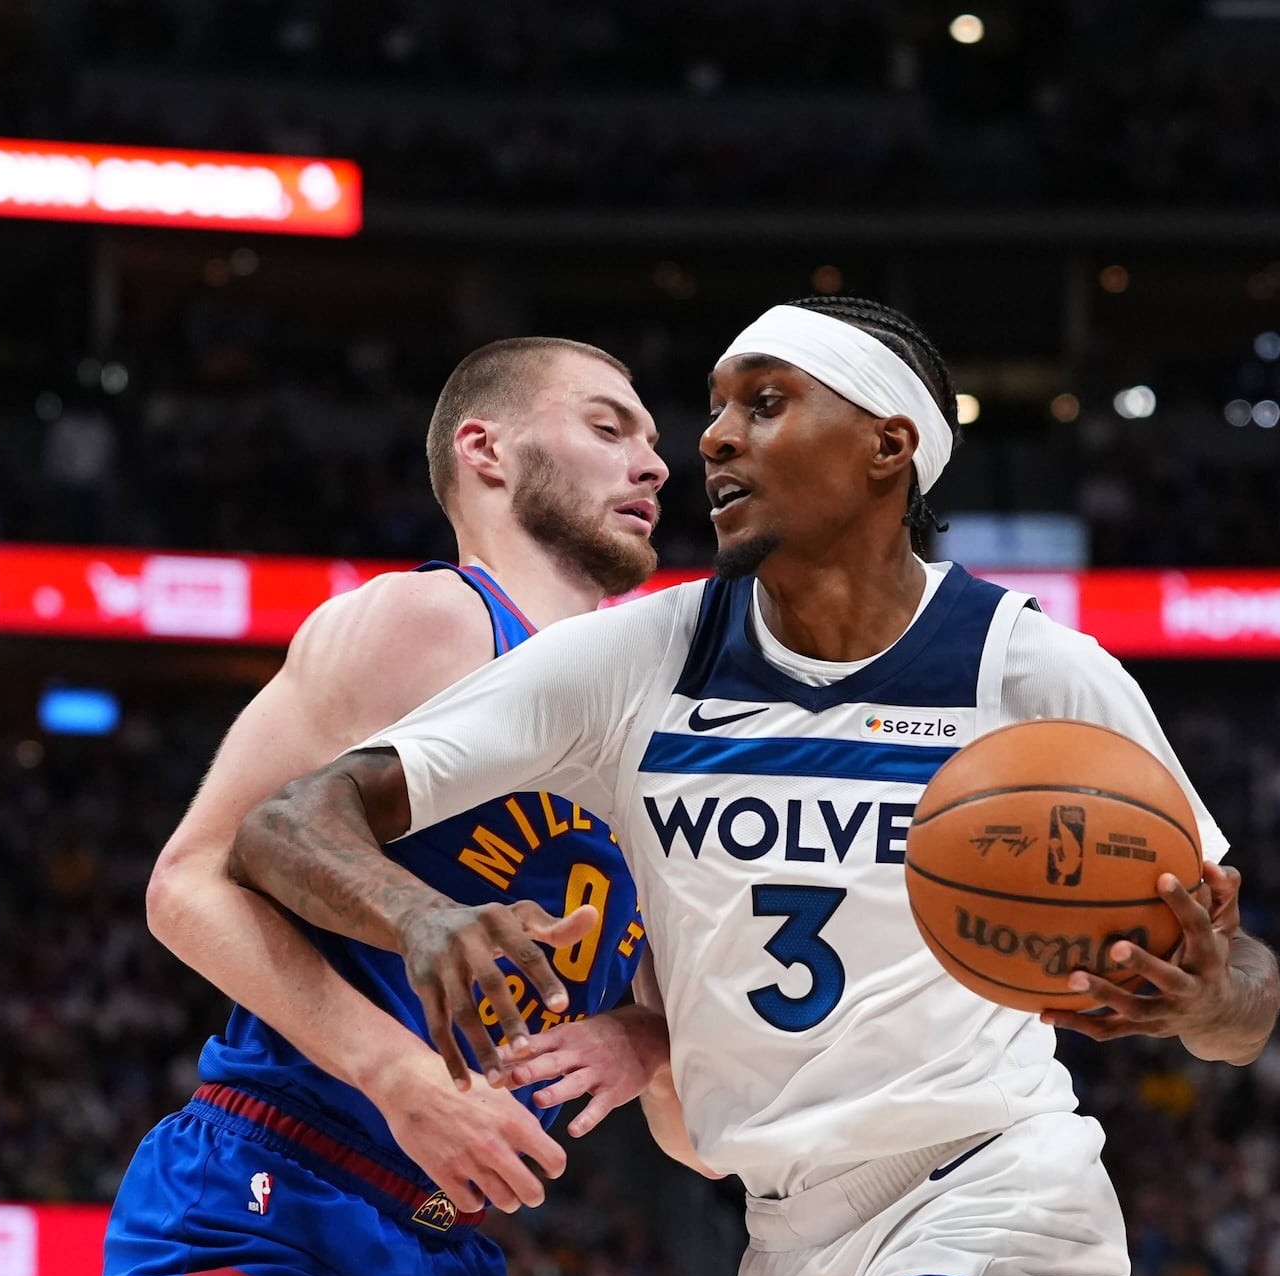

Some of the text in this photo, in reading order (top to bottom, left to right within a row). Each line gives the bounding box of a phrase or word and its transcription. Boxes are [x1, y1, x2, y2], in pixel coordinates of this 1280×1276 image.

[882, 717, 957, 738] sezzle
[643, 796, 919, 864] WOLVE
[746, 883, 847, 1033] 3
